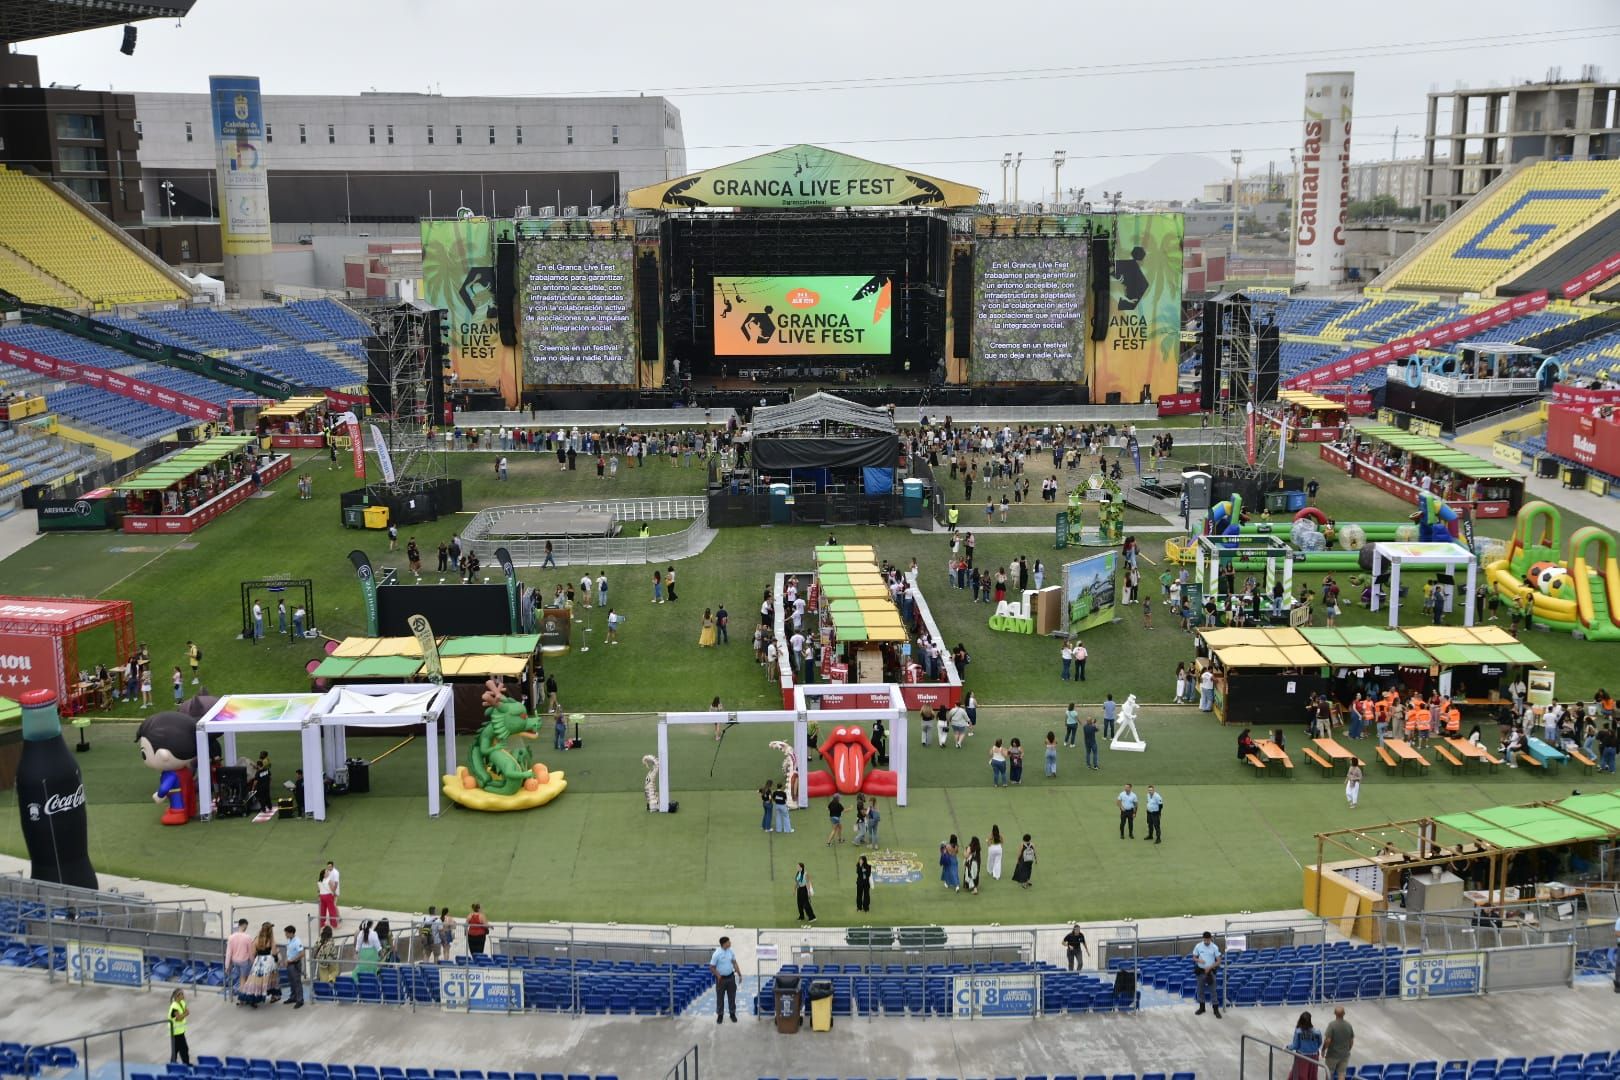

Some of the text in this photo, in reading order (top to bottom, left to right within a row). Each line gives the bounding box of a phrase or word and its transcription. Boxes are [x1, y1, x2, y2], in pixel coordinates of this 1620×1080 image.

[712, 178, 895, 196] GRANCA LIVE FEST
[1298, 120, 1323, 246] Canarias
[460, 322, 498, 334] GRAN
[778, 314, 850, 328] GRANCA
[1110, 315, 1148, 327] ANCA
[462, 335, 491, 346] LIVE
[778, 328, 865, 344] LIVE FEST
[1119, 328, 1148, 338] LIVE
[462, 347, 496, 358] FEST
[1113, 340, 1148, 350] FEST
[1573, 434, 1596, 454] Mahou
[72, 954, 106, 972] C16
[1406, 968, 1443, 985] C19
[444, 981, 481, 998] C17
[957, 988, 998, 1004] C18
